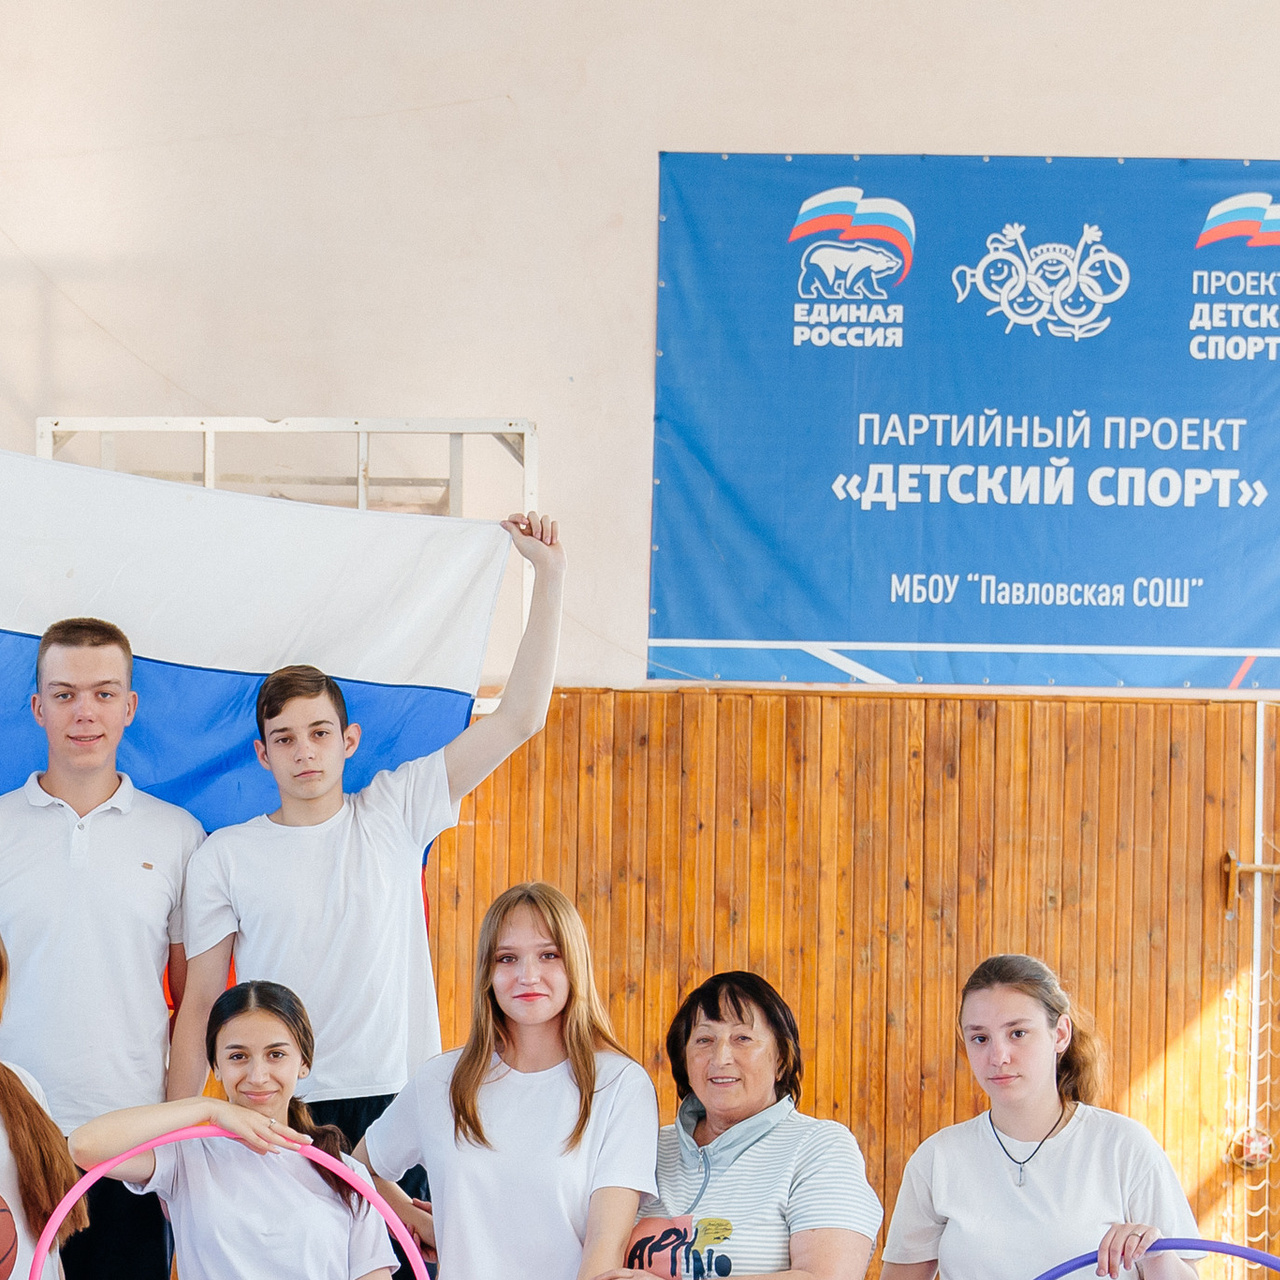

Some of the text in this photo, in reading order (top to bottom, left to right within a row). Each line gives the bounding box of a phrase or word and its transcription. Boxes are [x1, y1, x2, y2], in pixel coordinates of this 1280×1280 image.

[1192, 270, 1280, 296] ПРОЕК
[793, 303, 904, 325] ЕДИНАЯ
[793, 326, 904, 348] РОССИЯ
[1189, 334, 1280, 361] СПОРТ
[858, 408, 1248, 452] ПАРТИЙНЫЙ ПРОЕКТ
[831, 456, 1269, 511] «ДЕТСКИЙ СПОРТ»
[890, 574, 960, 604] МБОУ
